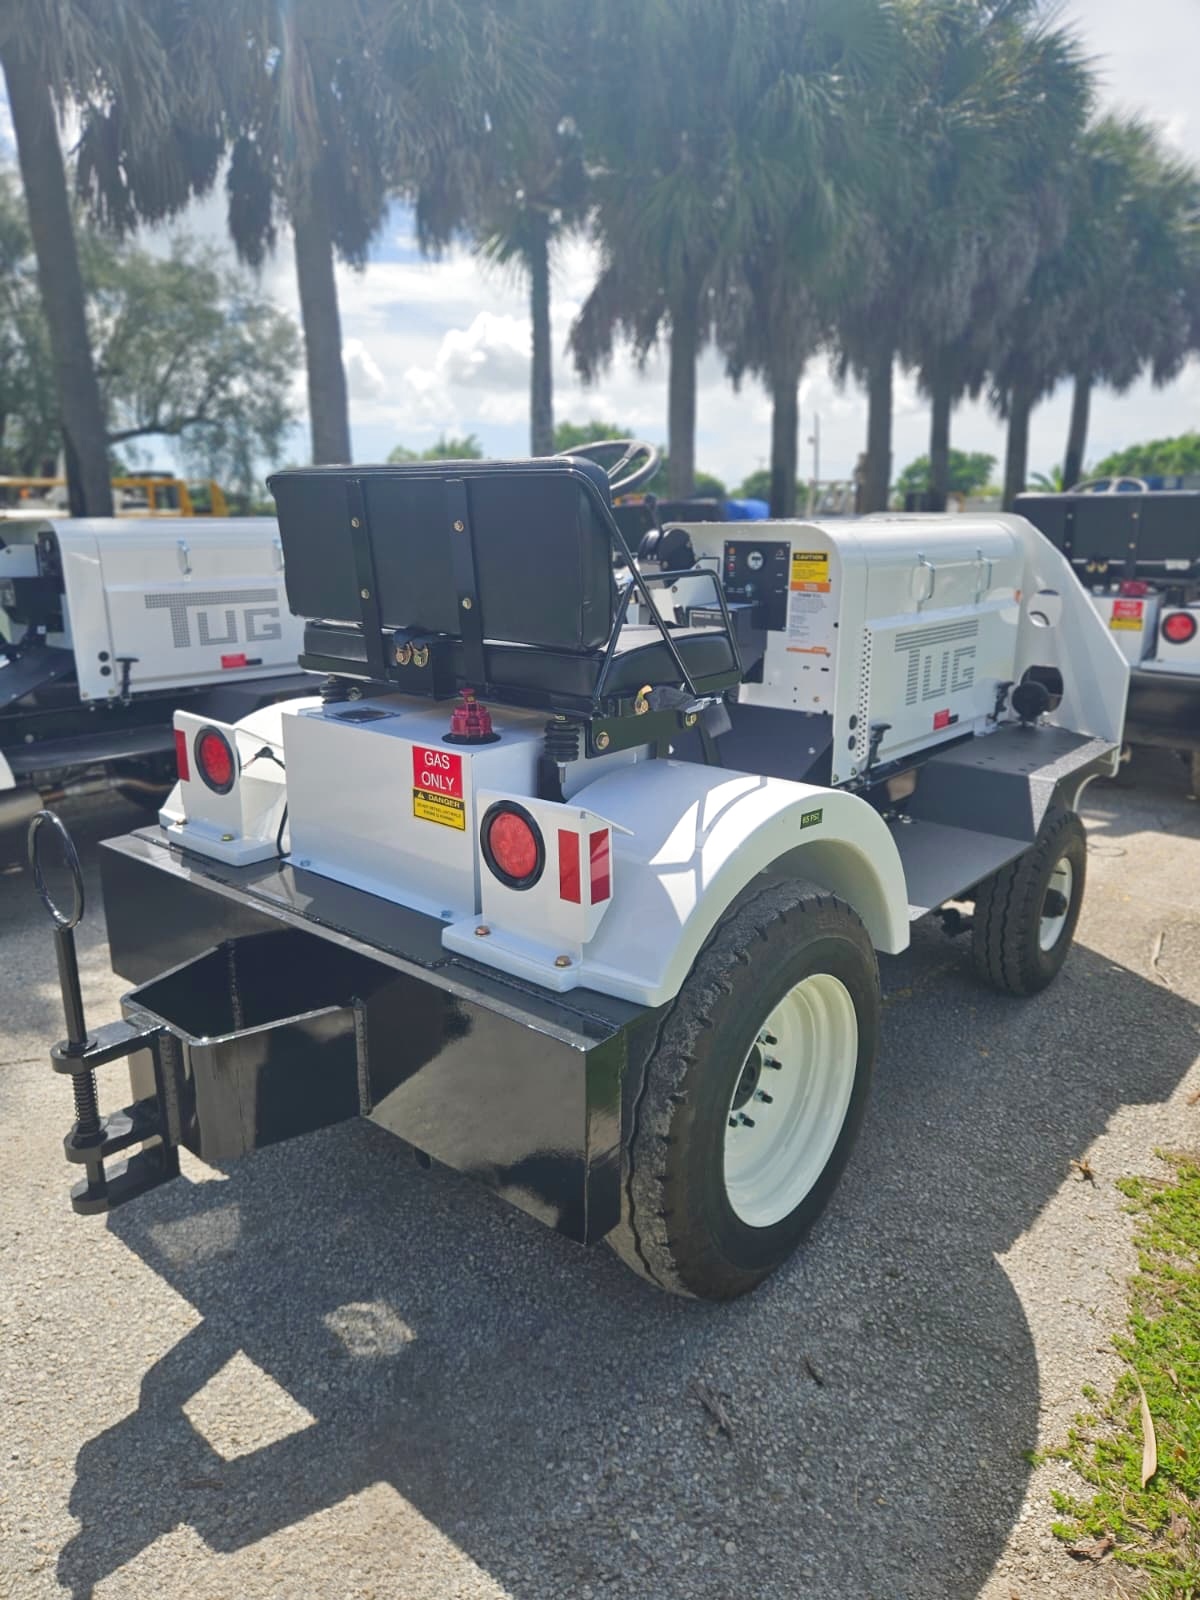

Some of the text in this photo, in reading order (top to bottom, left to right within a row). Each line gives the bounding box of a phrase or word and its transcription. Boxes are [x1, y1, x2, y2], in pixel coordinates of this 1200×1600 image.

[144, 588, 282, 648] TUG
[894, 620, 979, 705] TUG
[424, 751, 450, 770] GAS
[421, 771, 454, 791] ONLY
[428, 794, 460, 809] DANGER
